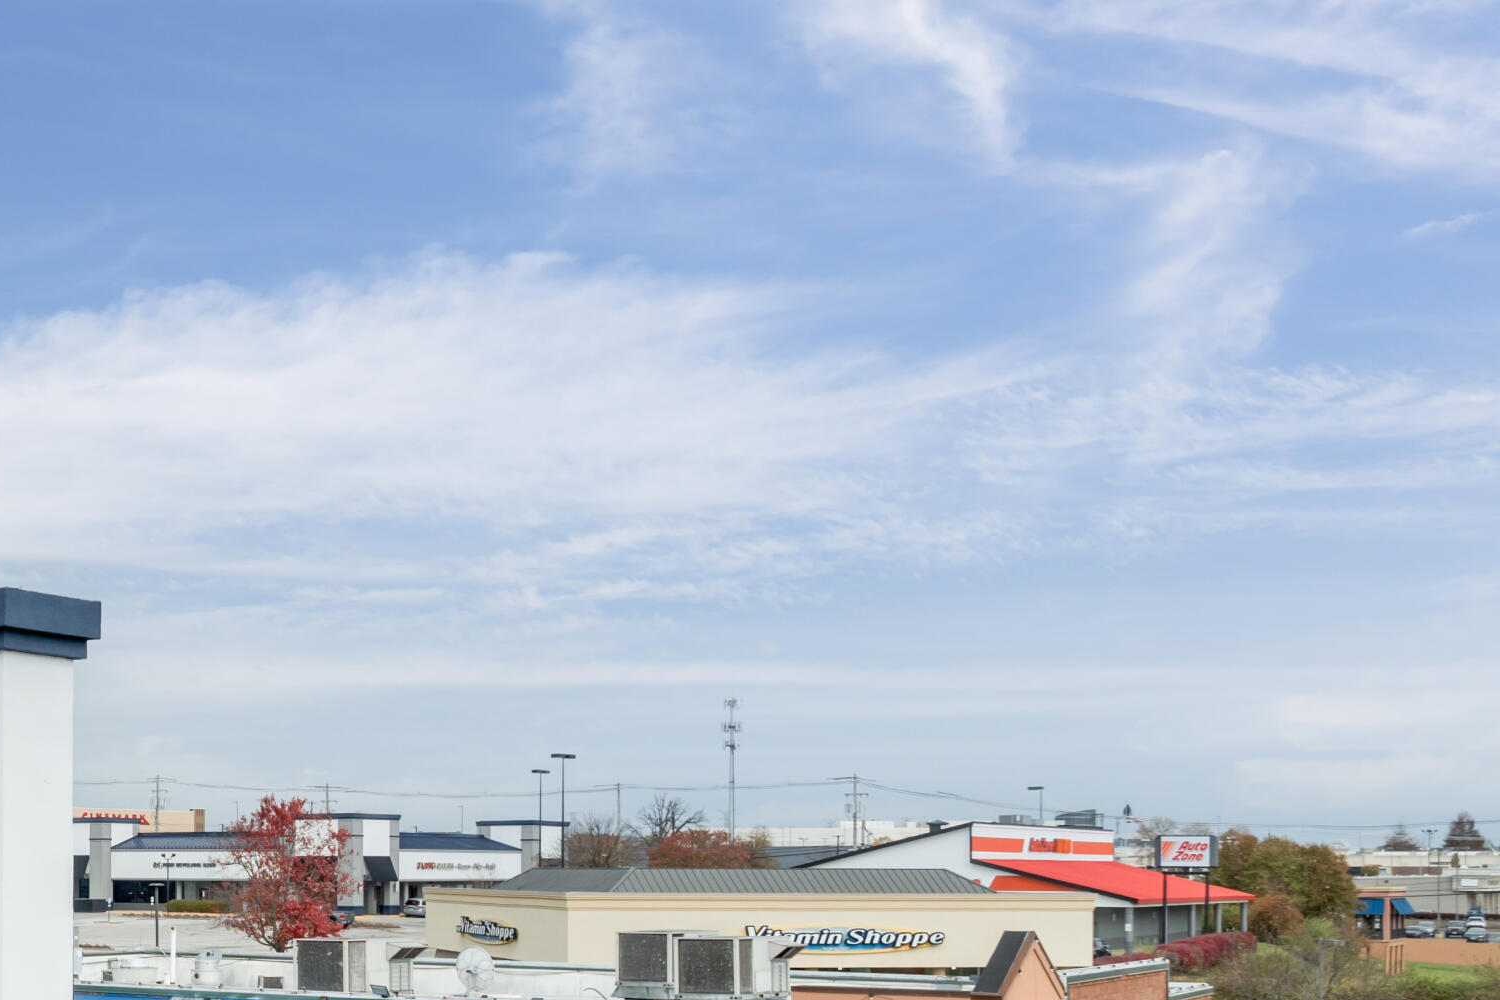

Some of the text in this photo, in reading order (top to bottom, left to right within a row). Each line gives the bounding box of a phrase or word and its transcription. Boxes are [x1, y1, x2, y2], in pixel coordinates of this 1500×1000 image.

[1180, 841, 1208, 851] Auto
[1172, 851, 1204, 861] Zone
[460, 916, 516, 941] Vitamin Shoppe
[846, 927, 945, 948] Shoppe
